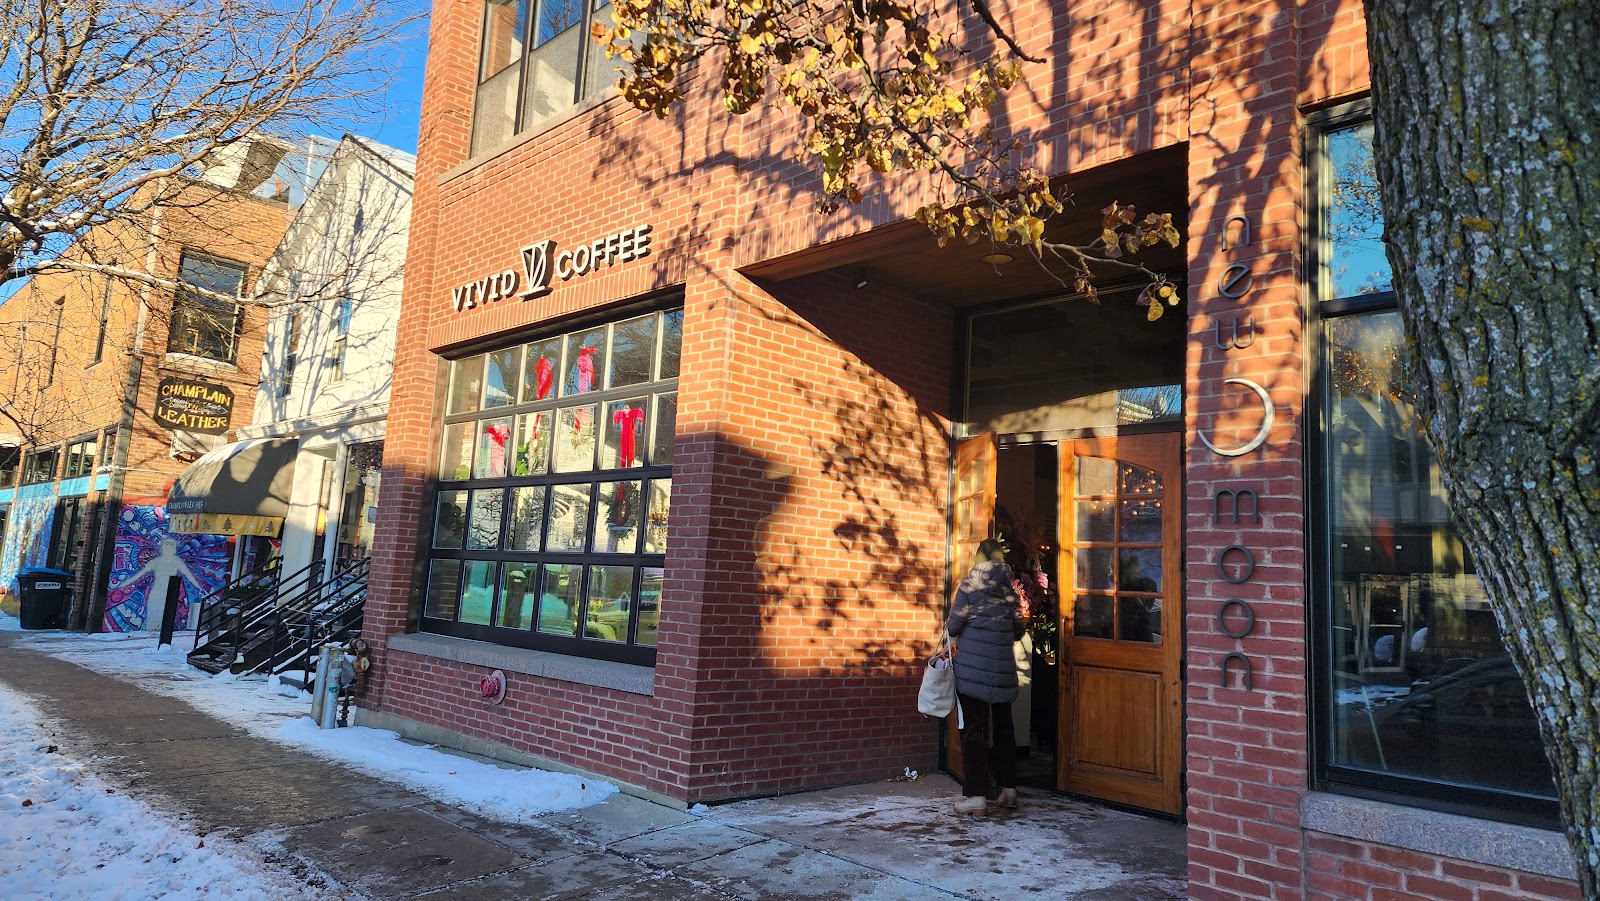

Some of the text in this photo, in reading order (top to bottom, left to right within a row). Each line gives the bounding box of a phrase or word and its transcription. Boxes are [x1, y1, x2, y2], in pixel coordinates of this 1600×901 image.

[451, 224, 652, 312] VIVID COFFEE
[1215, 214, 1256, 350] new
[158, 406, 227, 429] LEATHER
[161, 384, 231, 407] CHAMPLAIN
[1214, 488, 1259, 690] moon
